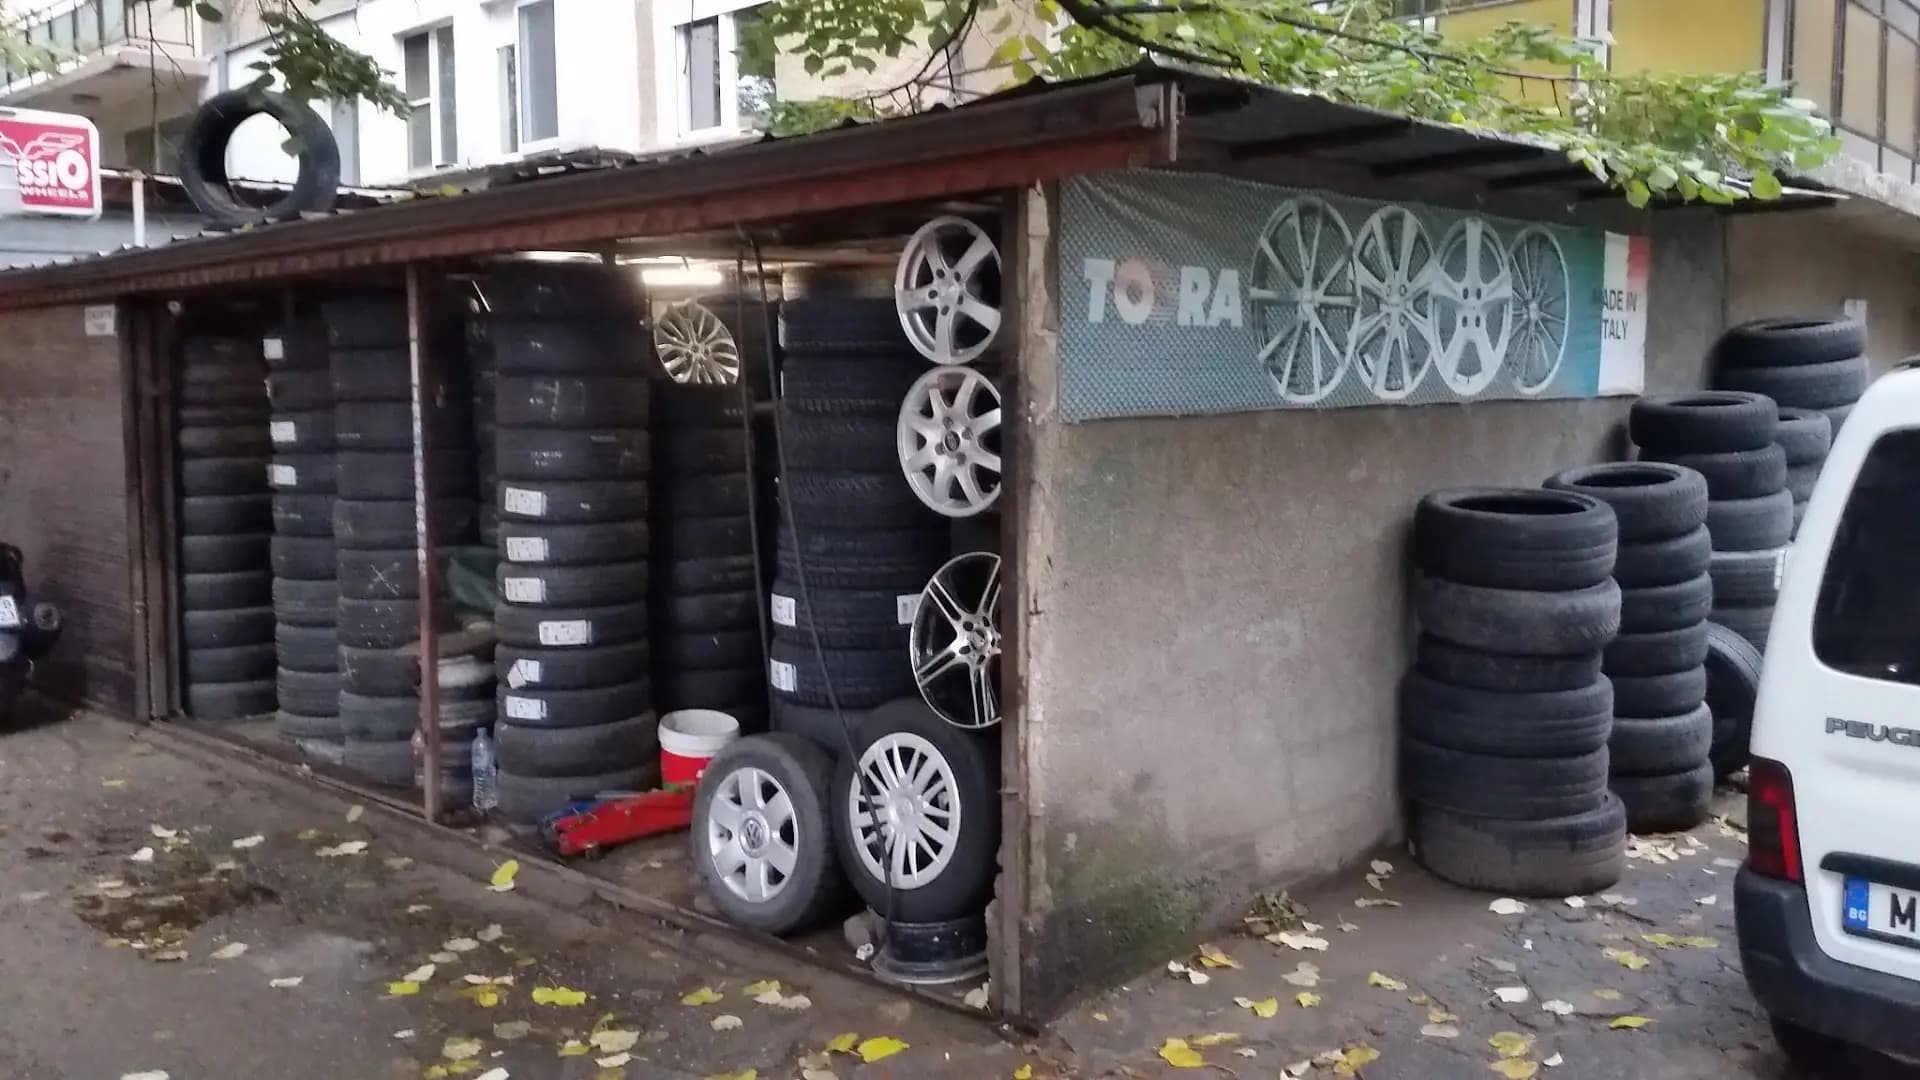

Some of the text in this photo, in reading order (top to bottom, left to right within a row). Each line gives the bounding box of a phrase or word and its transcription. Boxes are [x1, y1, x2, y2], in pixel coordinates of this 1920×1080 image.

[1592, 288, 1638, 313] MADE IN
[1849, 906, 1867, 921] BG
[1890, 892, 1917, 933] M
